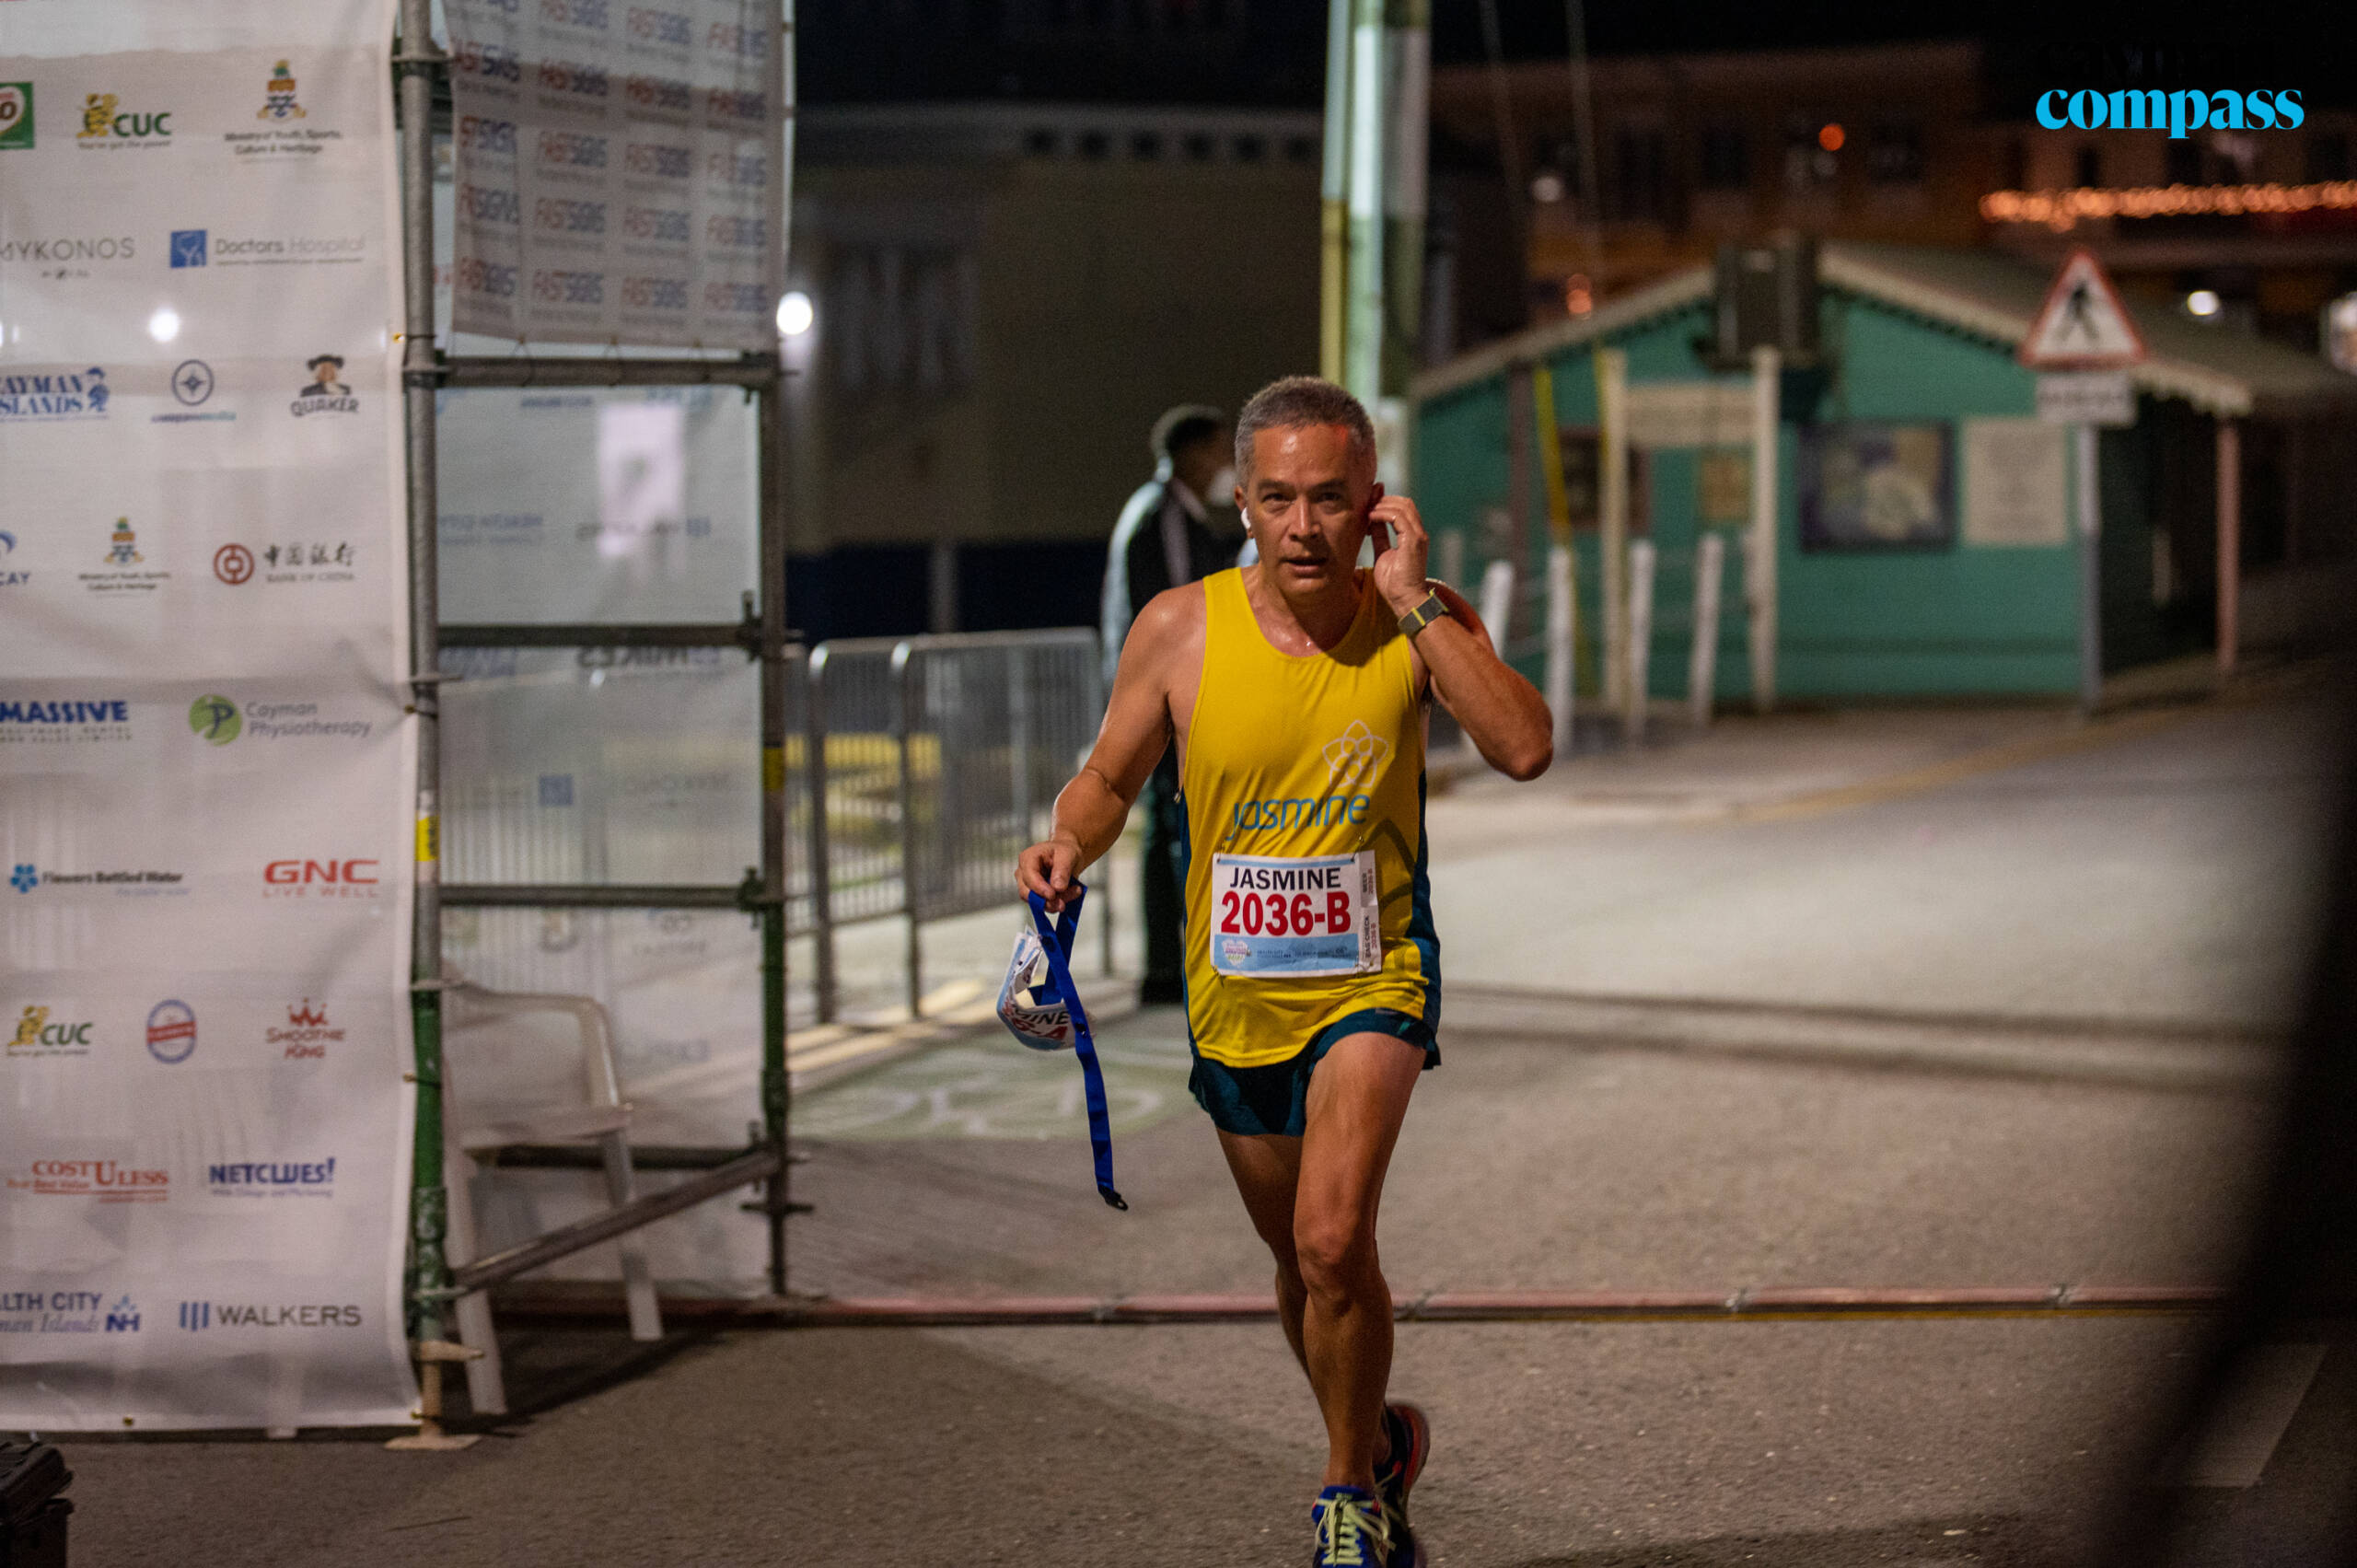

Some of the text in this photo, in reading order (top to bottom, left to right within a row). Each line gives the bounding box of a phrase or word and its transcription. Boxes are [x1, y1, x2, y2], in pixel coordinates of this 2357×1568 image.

[114, 111, 172, 137] CUC
[215, 238, 284, 255] Doctors
[0, 374, 83, 394] AYMAN
[0, 396, 84, 414] SLANDS
[290, 397, 359, 417] QUAKER
[0, 700, 129, 724] MASSIVE
[245, 701, 318, 718] Cayman
[249, 718, 372, 738] Physiotherapy
[1225, 794, 1371, 842] jasmine
[264, 859, 379, 885] GNC
[1229, 866, 1341, 891] JASMINE
[262, 885, 378, 898] LIVE WELL
[1221, 889, 1352, 937] 2036-B
[41, 1021, 92, 1046] CUC
[0, 1292, 103, 1312] LTH CITY
[105, 1313, 141, 1332] NH
[217, 1304, 363, 1328] WALKERS
